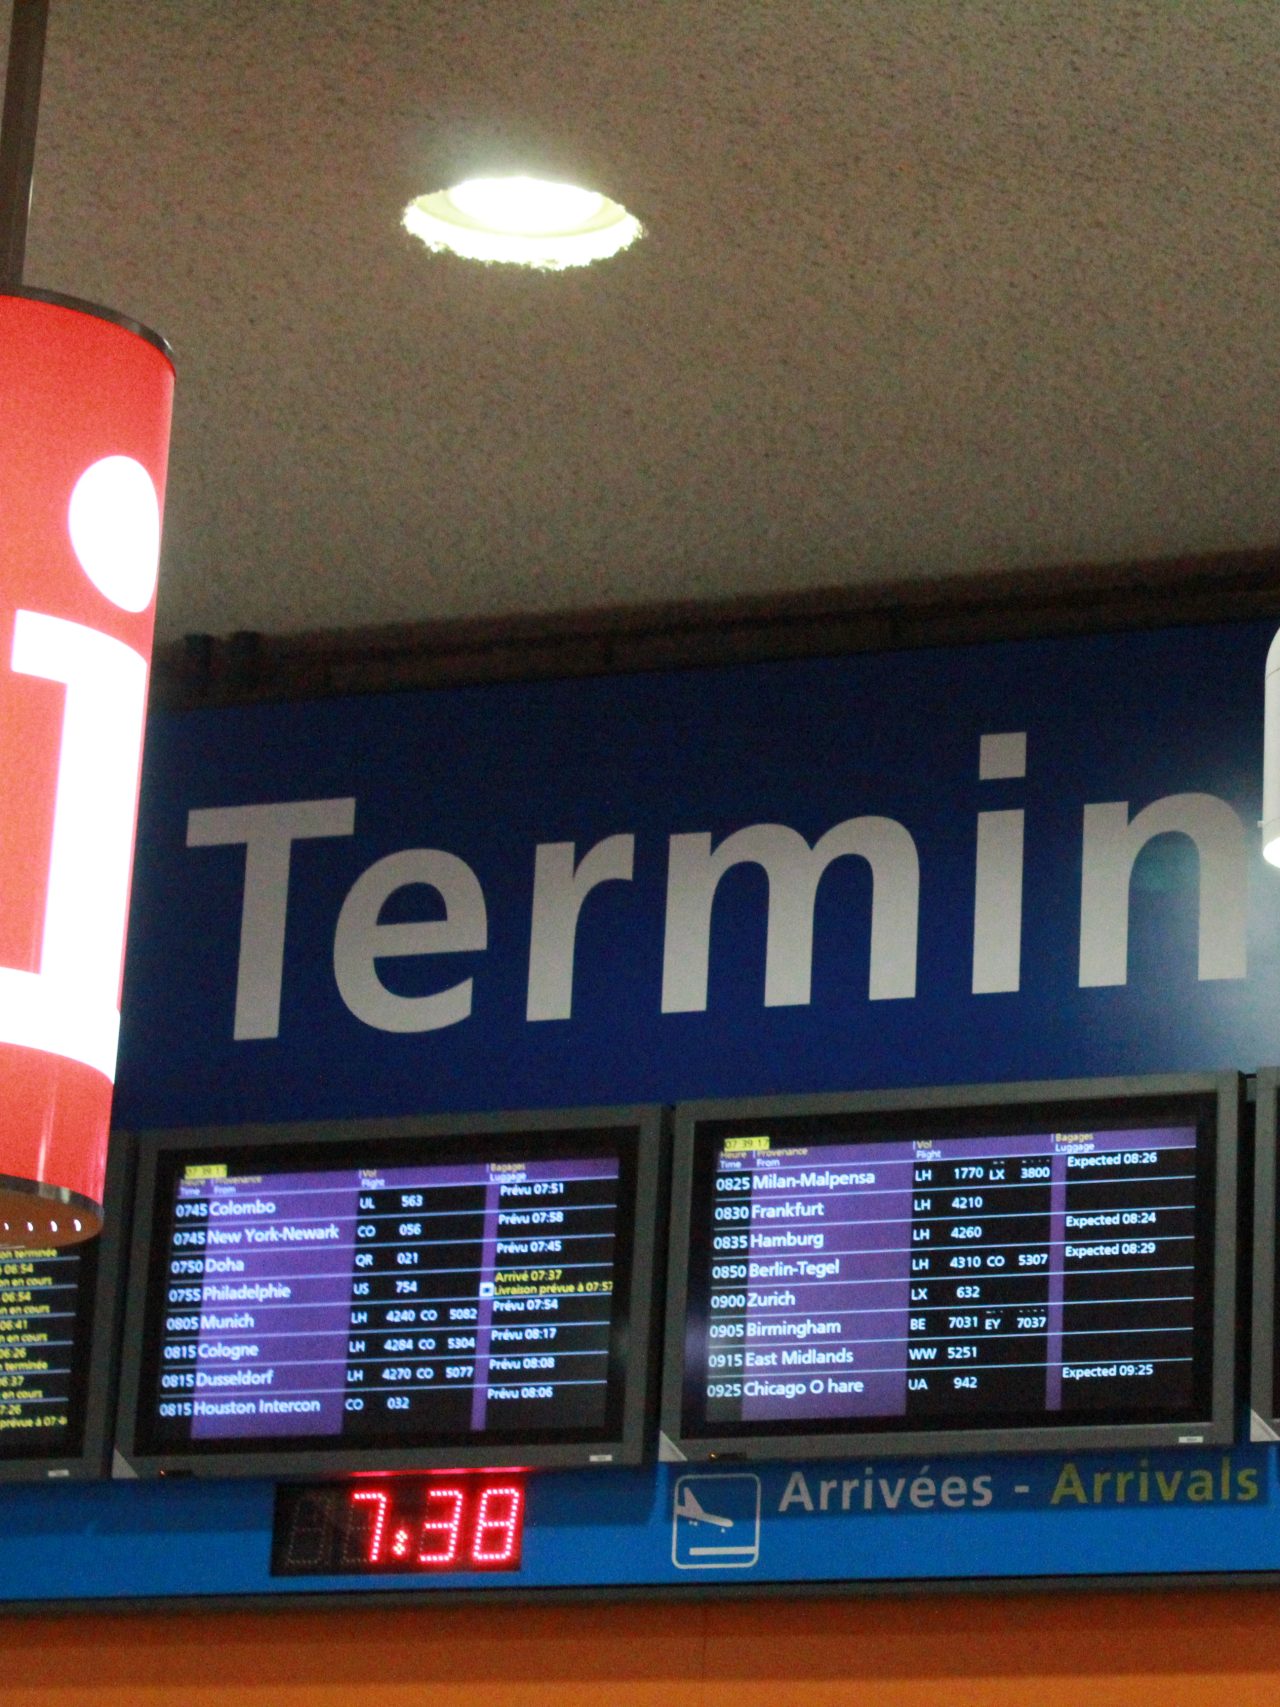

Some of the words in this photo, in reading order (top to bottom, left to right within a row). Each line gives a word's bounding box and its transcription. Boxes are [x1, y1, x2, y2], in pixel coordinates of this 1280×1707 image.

[1068, 1154, 1121, 1168] Expected
[1124, 1152, 1157, 1164] 08:26
[716, 1177, 750, 1191] 0825
[753, 1171, 875, 1189] Milan-Malpensa
[955, 1167, 983, 1179] 1770
[500, 1183, 532, 1195] Prévu
[534, 1183, 563, 1194] 07:51
[176, 1204, 208, 1217] 0745
[210, 1199, 276, 1216] Colombo
[715, 1206, 749, 1220] 0830
[752, 1202, 824, 1218] Frankfurt
[952, 1196, 982, 1208] 4210
[498, 1212, 528, 1224] Prévu
[532, 1211, 563, 1223] 07:58
[174, 1232, 206, 1245] 0745
[208, 1230, 242, 1244] New
[245, 1224, 339, 1242] York-Newark
[714, 1236, 748, 1249] 0835
[751, 1232, 824, 1248] Hamburg
[951, 1226, 982, 1238] 4260
[497, 1242, 528, 1253] Prévu
[530, 1240, 561, 1252] 07:45
[171, 1258, 204, 1273] 0750
[205, 1257, 244, 1272] Doha
[712, 1265, 746, 1278] 0850
[750, 1259, 839, 1278] Berlin-Tegel
[950, 1256, 981, 1268] 4310
[495, 1271, 529, 1282] Arrivé
[531, 1269, 562, 1281] 07:37
[169, 1288, 201, 1302] 0755
[203, 1284, 291, 1302] Philadelphie
[711, 1295, 746, 1308] 0900
[747, 1290, 795, 1307] Zurich
[957, 1286, 980, 1298] 632
[166, 1316, 199, 1330] 0805
[201, 1313, 254, 1329] Munich
[710, 1324, 744, 1338] 0905
[747, 1319, 841, 1338] Birmingham
[949, 1316, 978, 1328] 7031
[164, 1345, 196, 1359] 0815
[198, 1342, 259, 1360] Cologne
[709, 1354, 742, 1367] 0915
[746, 1352, 777, 1366] East
[782, 1348, 853, 1364] Midlands
[948, 1346, 976, 1358] 5251
[162, 1374, 194, 1388] 0815
[196, 1370, 273, 1386] Dusseldorf
[1062, 1365, 1116, 1380] Expected
[1119, 1364, 1153, 1376] 09:25
[707, 1384, 741, 1397] 0925
[744, 1381, 806, 1398] Chicago
[810, 1380, 824, 1394] O
[828, 1378, 864, 1392] hare
[954, 1377, 977, 1388] 942
[160, 1402, 192, 1416] 0815
[194, 1402, 256, 1415] Houston
[259, 1400, 320, 1413] Intercon
[778, 1466, 994, 1512] Arrivées
[1050, 1457, 1258, 1504] Arrivals
[352, 1489, 521, 1566] 7:38
